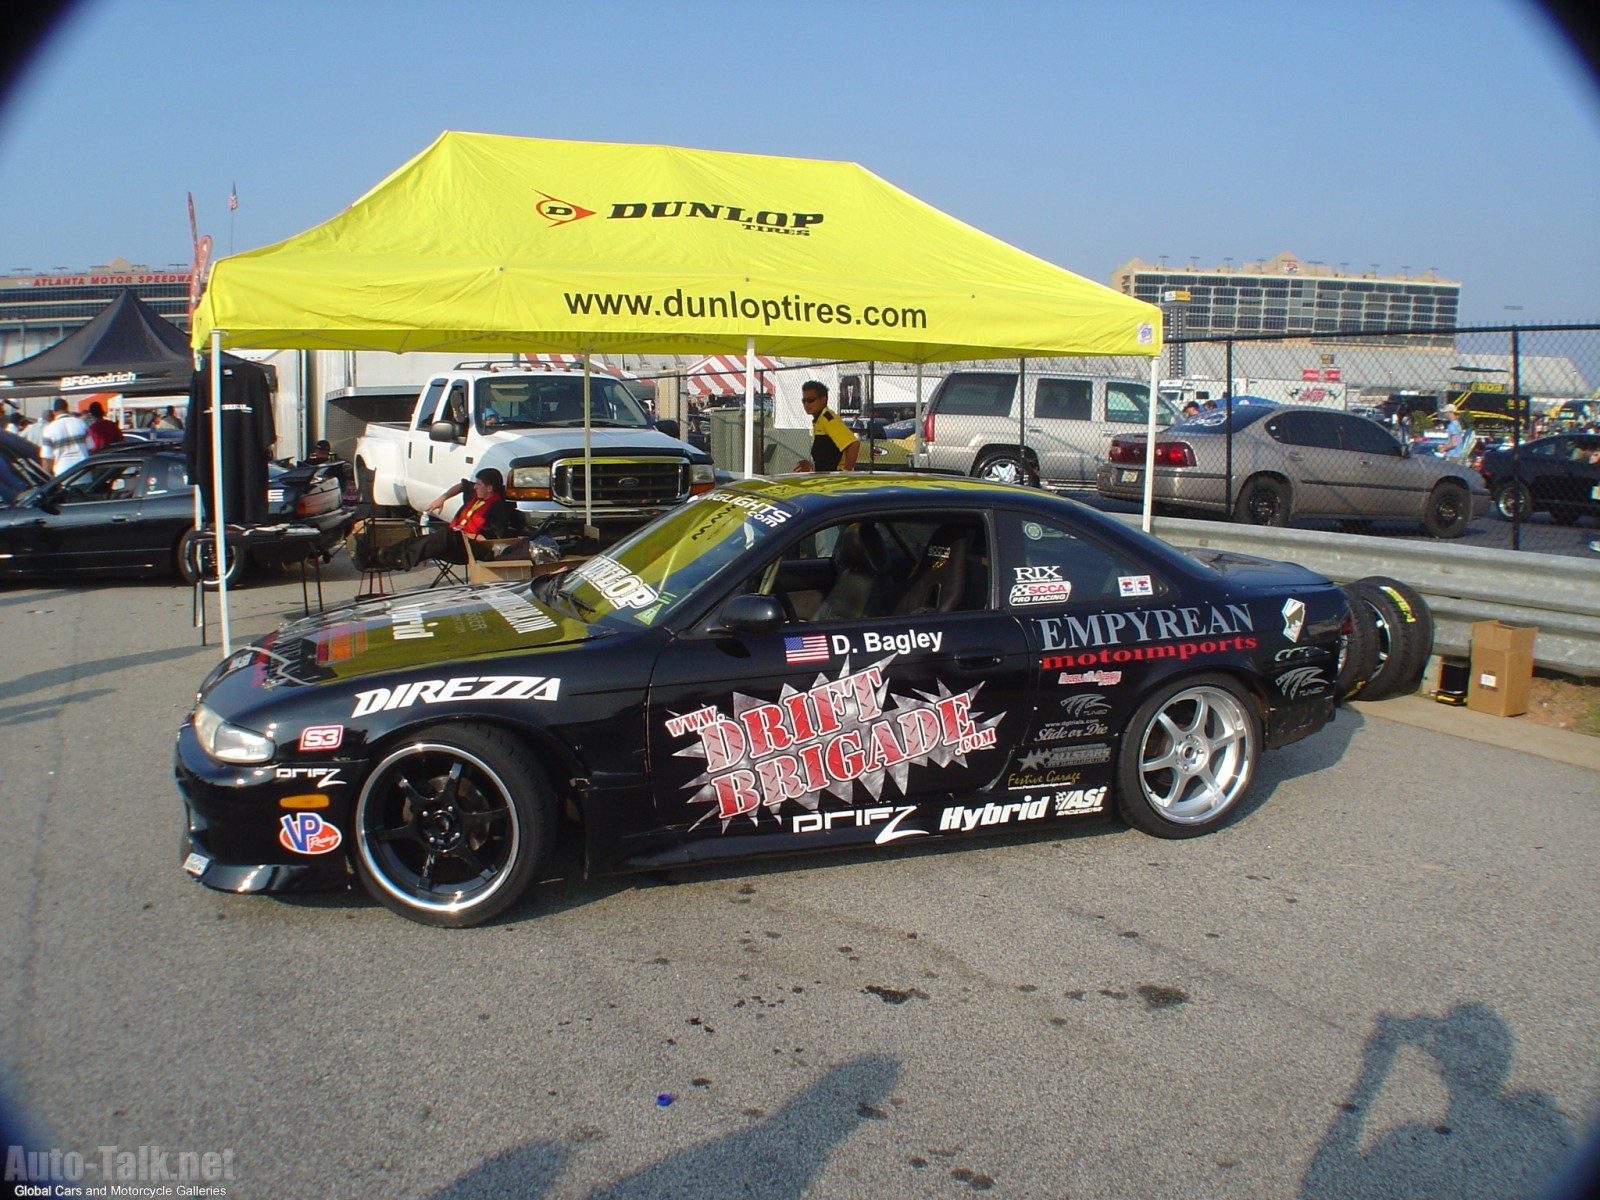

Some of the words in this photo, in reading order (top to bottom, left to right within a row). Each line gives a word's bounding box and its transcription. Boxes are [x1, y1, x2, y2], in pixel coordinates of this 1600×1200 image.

[606, 201, 825, 229] DUNLOP
[742, 224, 811, 236] TIRES
[33, 277, 85, 287] ATLANTA
[91, 276, 133, 284] MOTOR
[138, 274, 193, 284] SPEEDWA
[563, 288, 928, 330] www.dunloptires.com
[60, 371, 137, 388] BFGoodrich
[743, 509, 779, 528] .com
[1013, 565, 1063, 580] RIX
[1028, 584, 1067, 595] SCCA
[1031, 593, 1066, 602] RACING
[1036, 603, 1254, 651] EMPYREAN
[831, 633, 858, 655] D.
[863, 630, 943, 655] Bagley
[1041, 635, 1258, 670] motoimports
[351, 676, 562, 718] DIREZZA
[696, 666, 883, 774] DRIFT
[1034, 726, 1068, 741] Slide
[1084, 723, 1109, 736] Die
[304, 728, 340, 747] S3
[954, 727, 997, 756] .COM
[710, 692, 974, 819] BRIGADE
[1007, 772, 1043, 787] Festive
[1046, 769, 1081, 785] Garage
[939, 795, 1050, 832] Hybrid
[280, 812, 322, 852] VP
[310, 834, 340, 848] Racing
